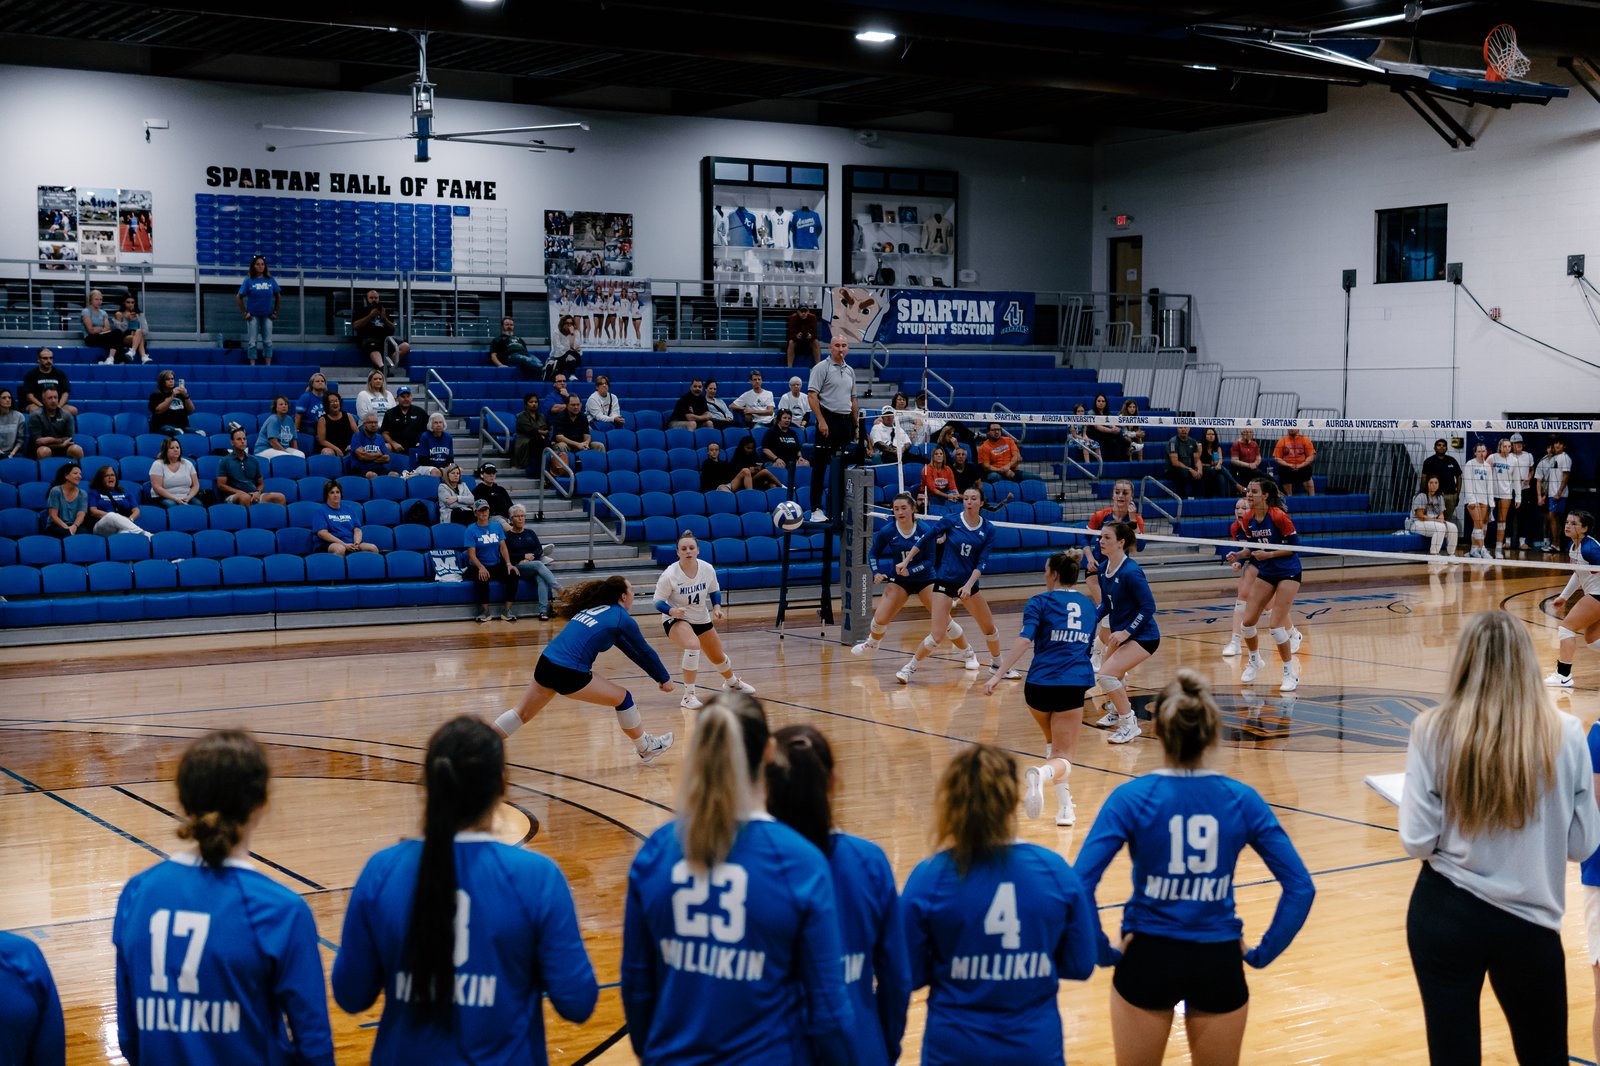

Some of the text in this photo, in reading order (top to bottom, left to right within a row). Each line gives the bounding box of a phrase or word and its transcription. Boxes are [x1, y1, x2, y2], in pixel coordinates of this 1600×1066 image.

[206, 165, 497, 201] SPARTAN HALL OF FAME
[934, 228, 944, 244] A
[897, 298, 996, 323] SPARTAN
[896, 322, 995, 336] STUDENT SECTION
[928, 411, 946, 419] AURORA
[947, 411, 975, 420] UNIVERSITY
[994, 413, 1021, 421] SPARTANS
[1063, 415, 1096, 423] UNIVERSITY
[1118, 416, 1149, 424] SPARTANS
[1172, 417, 1197, 425] AURORA
[1197, 418, 1236, 426] UNIVERSITY
[1262, 419, 1297, 427] SPARTANS
[1325, 420, 1354, 428] AURORA
[1355, 420, 1400, 429] UNIVERSITY
[1430, 420, 1472, 429] SPARTANS
[1505, 421, 1539, 430] AURORA
[1541, 421, 1594, 431] UNIVERSITY
[961, 542, 972, 557] 13
[844, 506, 854, 632] AURORA
[680, 582, 706, 595] MILLIKIN
[687, 592, 700, 605] 14
[1066, 602, 1082, 630] 2
[1168, 813, 1219, 875] 19
[671, 858, 749, 944] 23
[984, 881, 1021, 950] 4
[149, 908, 211, 994] 17
